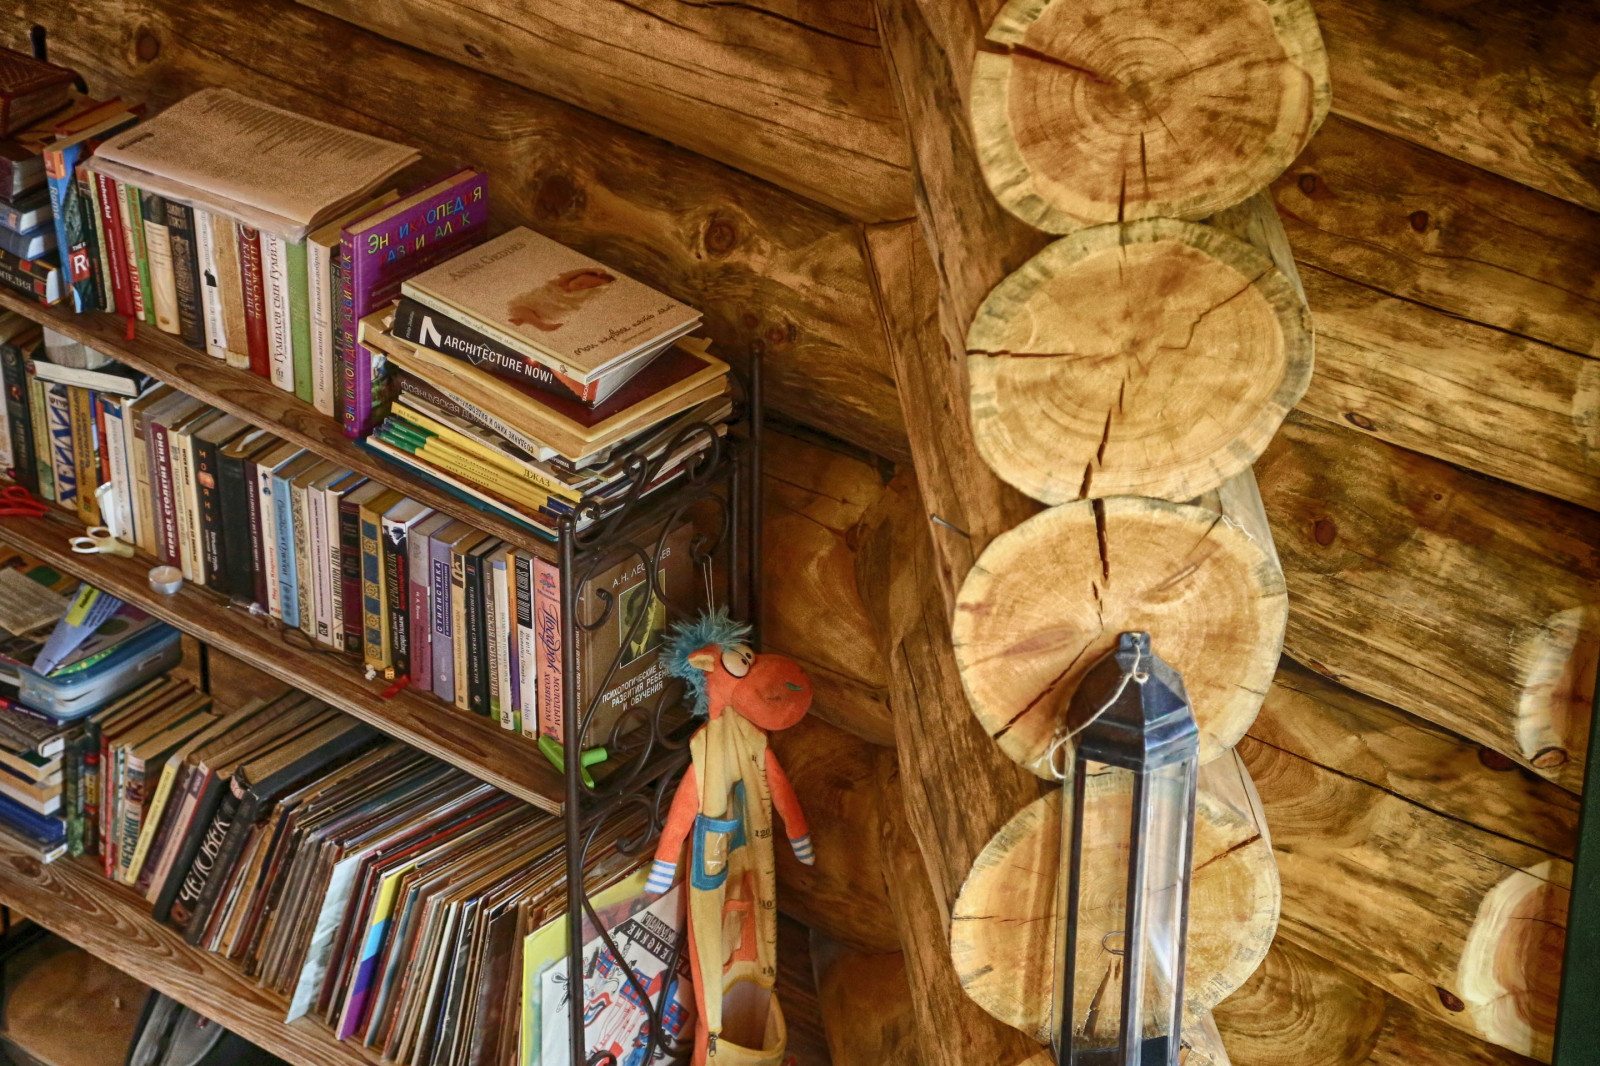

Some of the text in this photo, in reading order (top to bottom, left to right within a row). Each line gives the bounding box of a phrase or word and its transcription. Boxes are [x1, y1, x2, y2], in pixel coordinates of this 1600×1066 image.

[49, 185, 59, 219] Rome
[99, 173, 111, 218] itchenAid
[368, 186, 483, 255] ЭНЦИКЛОПЕДИЯ
[378, 212, 472, 266] РАЗВИВАЛОК
[242, 242, 254, 317] КЛАДБИЩЕ
[250, 244, 262, 319] ПРАЖСКОЕ
[272, 284, 280, 309] сын
[272, 310, 285, 364] Гумилев
[443, 335, 554, 384] ARCHITECTURE NOW!
[344, 332, 356, 421] ЭНЦИКЛОПЕДИЯ
[156, 431, 165, 462] КИНО
[160, 465, 171, 515] СТОЛЕТИЕ
[522, 468, 551, 487] ДЖАЗ
[166, 518, 175, 557] ПЕРВОЕ
[386, 549, 400, 609] СЕРЫЙ ВОЛК
[612, 577, 621, 588] А.
[620, 573, 629, 583] Н.
[485, 598, 498, 696] ДЕТСКАЯ ПСИХОЛОГИЯ
[537, 601, 562, 675] Подарок
[544, 673, 552, 721] ХОЗЯЙКАМ
[553, 676, 562, 726] МОЛОДЫМ
[601, 666, 658, 703] ПСИХОЛОГИЧЕСКИЕ
[611, 684, 645, 707] РАЗВИТИЯ
[622, 682, 664, 711] И ОБУЧЕНИЯ
[754, 829, 771, 839] 120
[179, 816, 231, 903] ЧЕЛОВЕК
